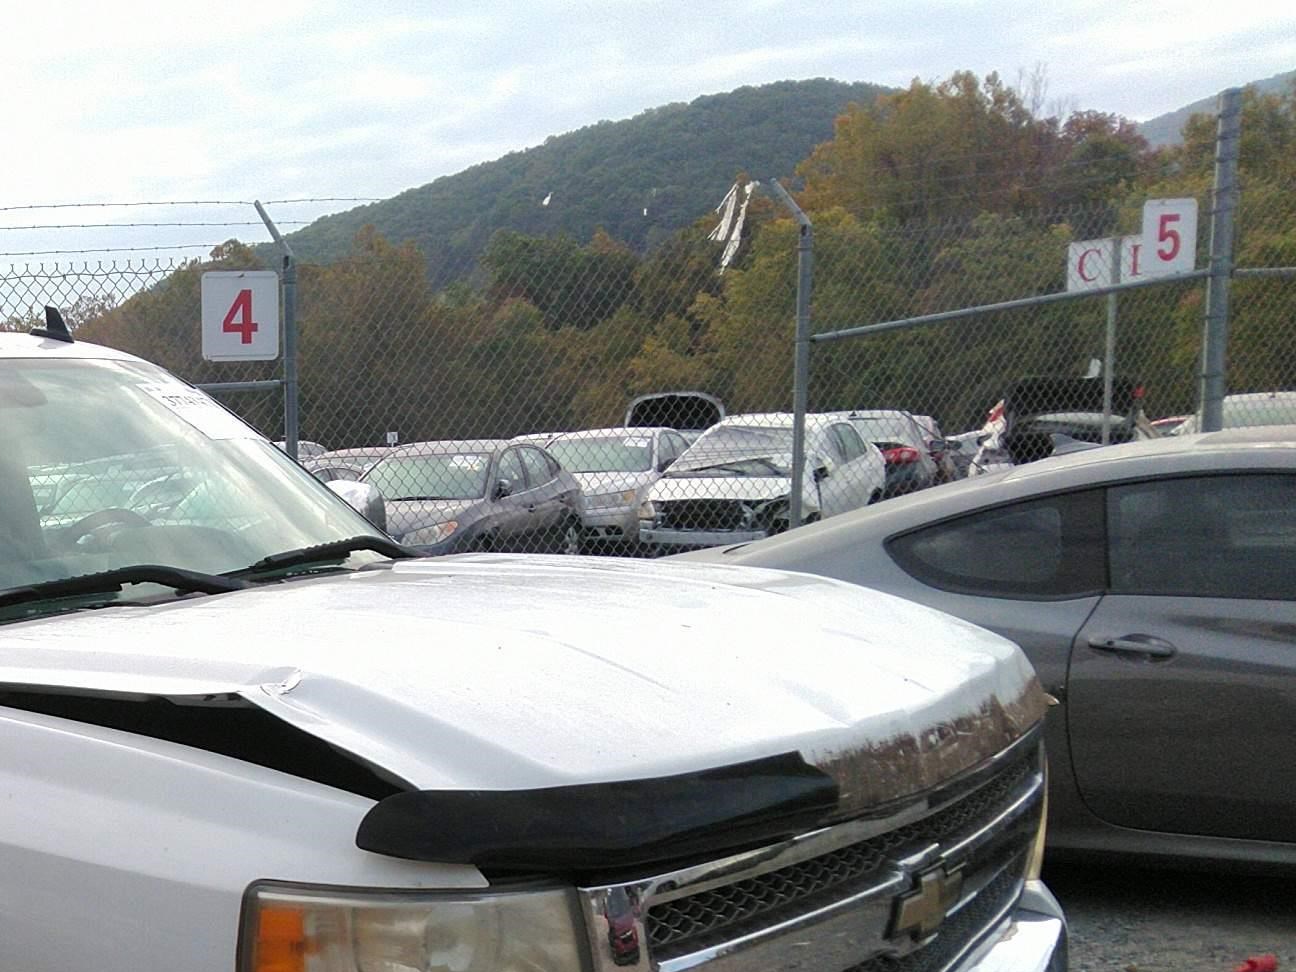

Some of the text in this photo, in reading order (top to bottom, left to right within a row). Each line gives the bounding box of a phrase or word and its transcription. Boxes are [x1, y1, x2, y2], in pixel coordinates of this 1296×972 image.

[1157, 213, 1181, 261] 5
[1077, 248, 1102, 282] C
[222, 289, 258, 344] 4
